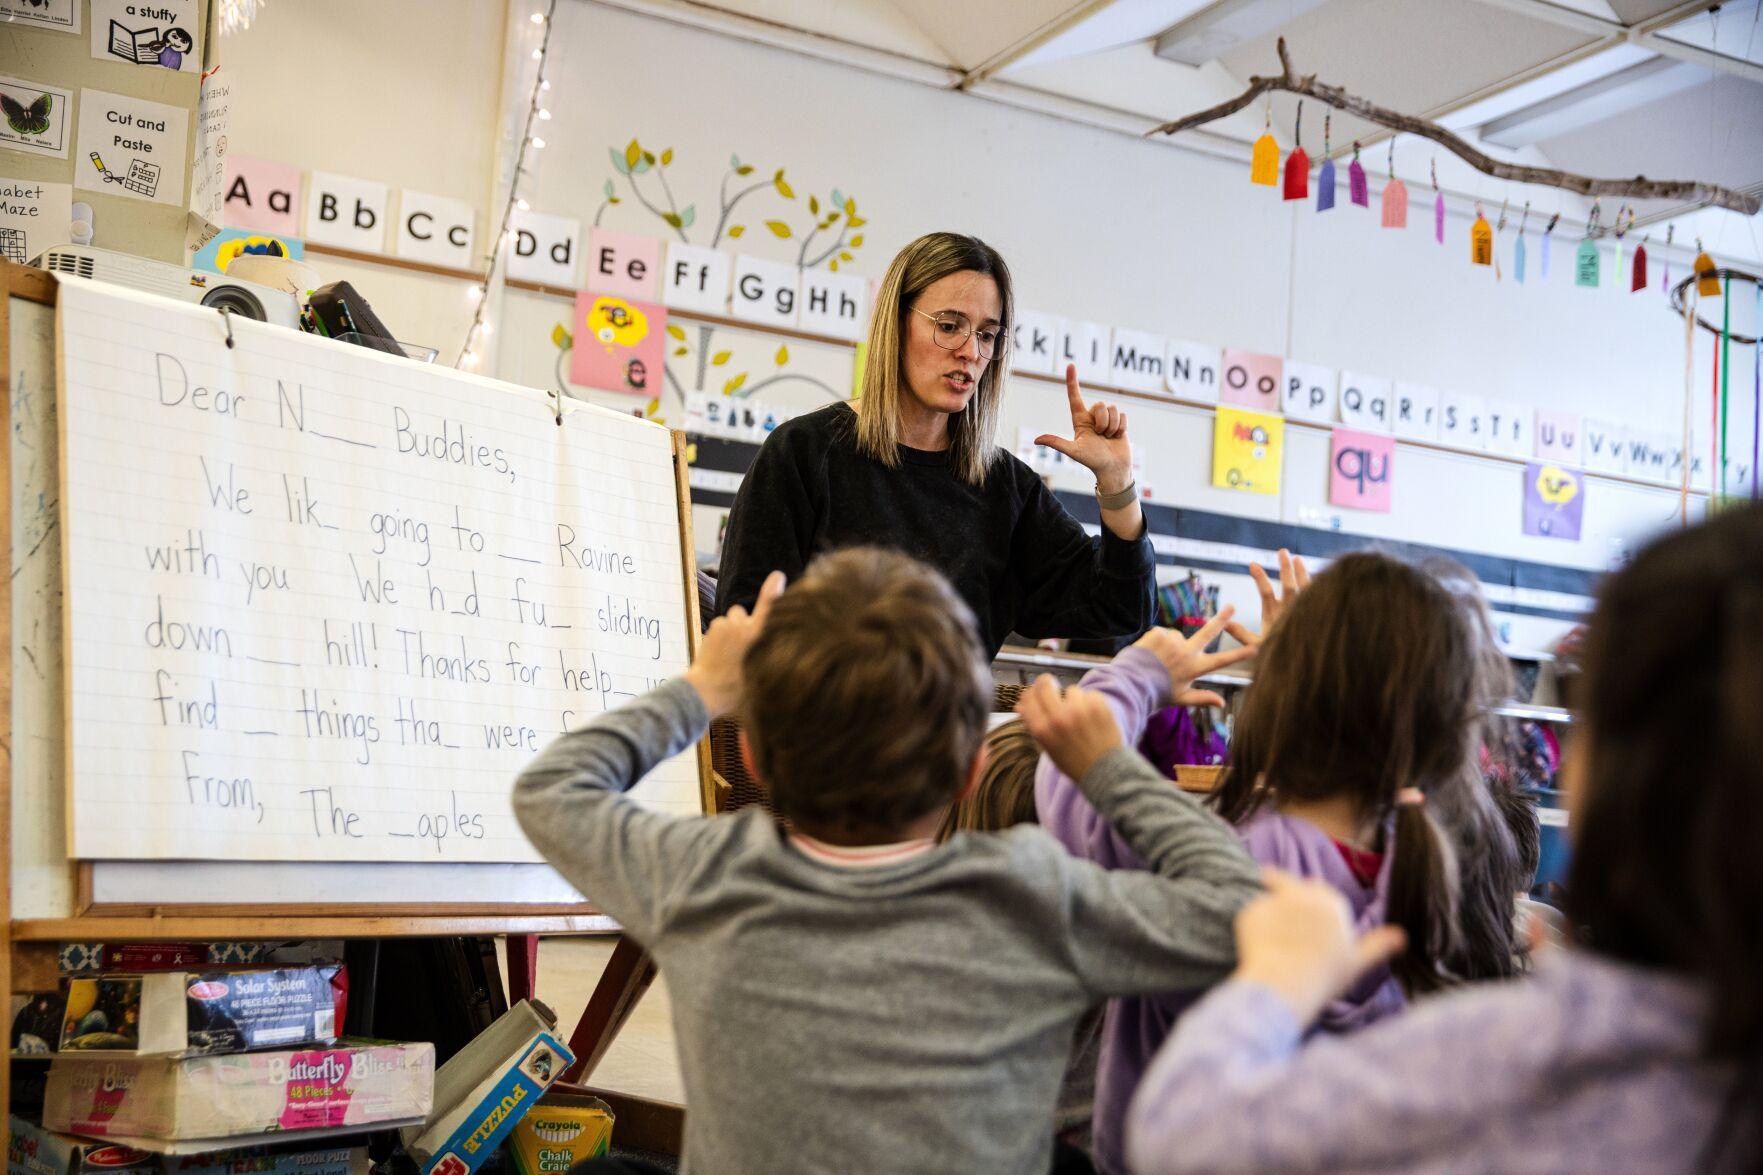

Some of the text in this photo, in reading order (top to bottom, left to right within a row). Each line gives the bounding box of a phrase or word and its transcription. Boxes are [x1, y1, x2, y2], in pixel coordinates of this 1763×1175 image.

[126, 6, 177, 24] a stuffy
[106, 110, 165, 132] Cut and
[113, 135, 153, 153] Paste
[0, 184, 44, 199] abet
[0, 201, 39, 217] Maze
[628, 358, 646, 389] e
[156, 353, 245, 418] Dear
[394, 406, 516, 483] Buddies,
[1336, 446, 1388, 494] qu
[200, 454, 253, 514] We
[370, 508, 431, 567] going
[451, 504, 485, 552] to
[557, 523, 636, 575] Ravine
[145, 529, 220, 579] with
[240, 561, 290, 606] you
[349, 552, 399, 604] We
[597, 595, 661, 660] sliding
[145, 593, 232, 658] down
[324, 619, 379, 668] hill!
[396, 628, 490, 683] Thanks
[506, 641, 541, 685] for
[154, 668, 218, 730] find
[296, 688, 380, 765] things
[483, 724, 537, 752] were
[182, 750, 264, 824] From,
[300, 786, 364, 838] The
[235, 980, 265, 995] Solar
[268, 978, 306, 996] System
[268, 1053, 345, 1084] Butterfly
[290, 1084, 333, 1099] 48 Pieces
[463, 1083, 528, 1154] PUZZLE
[535, 1119, 581, 1131] Crayola
[539, 1149, 573, 1161] Chalk
[539, 1160, 570, 1171] Craie
